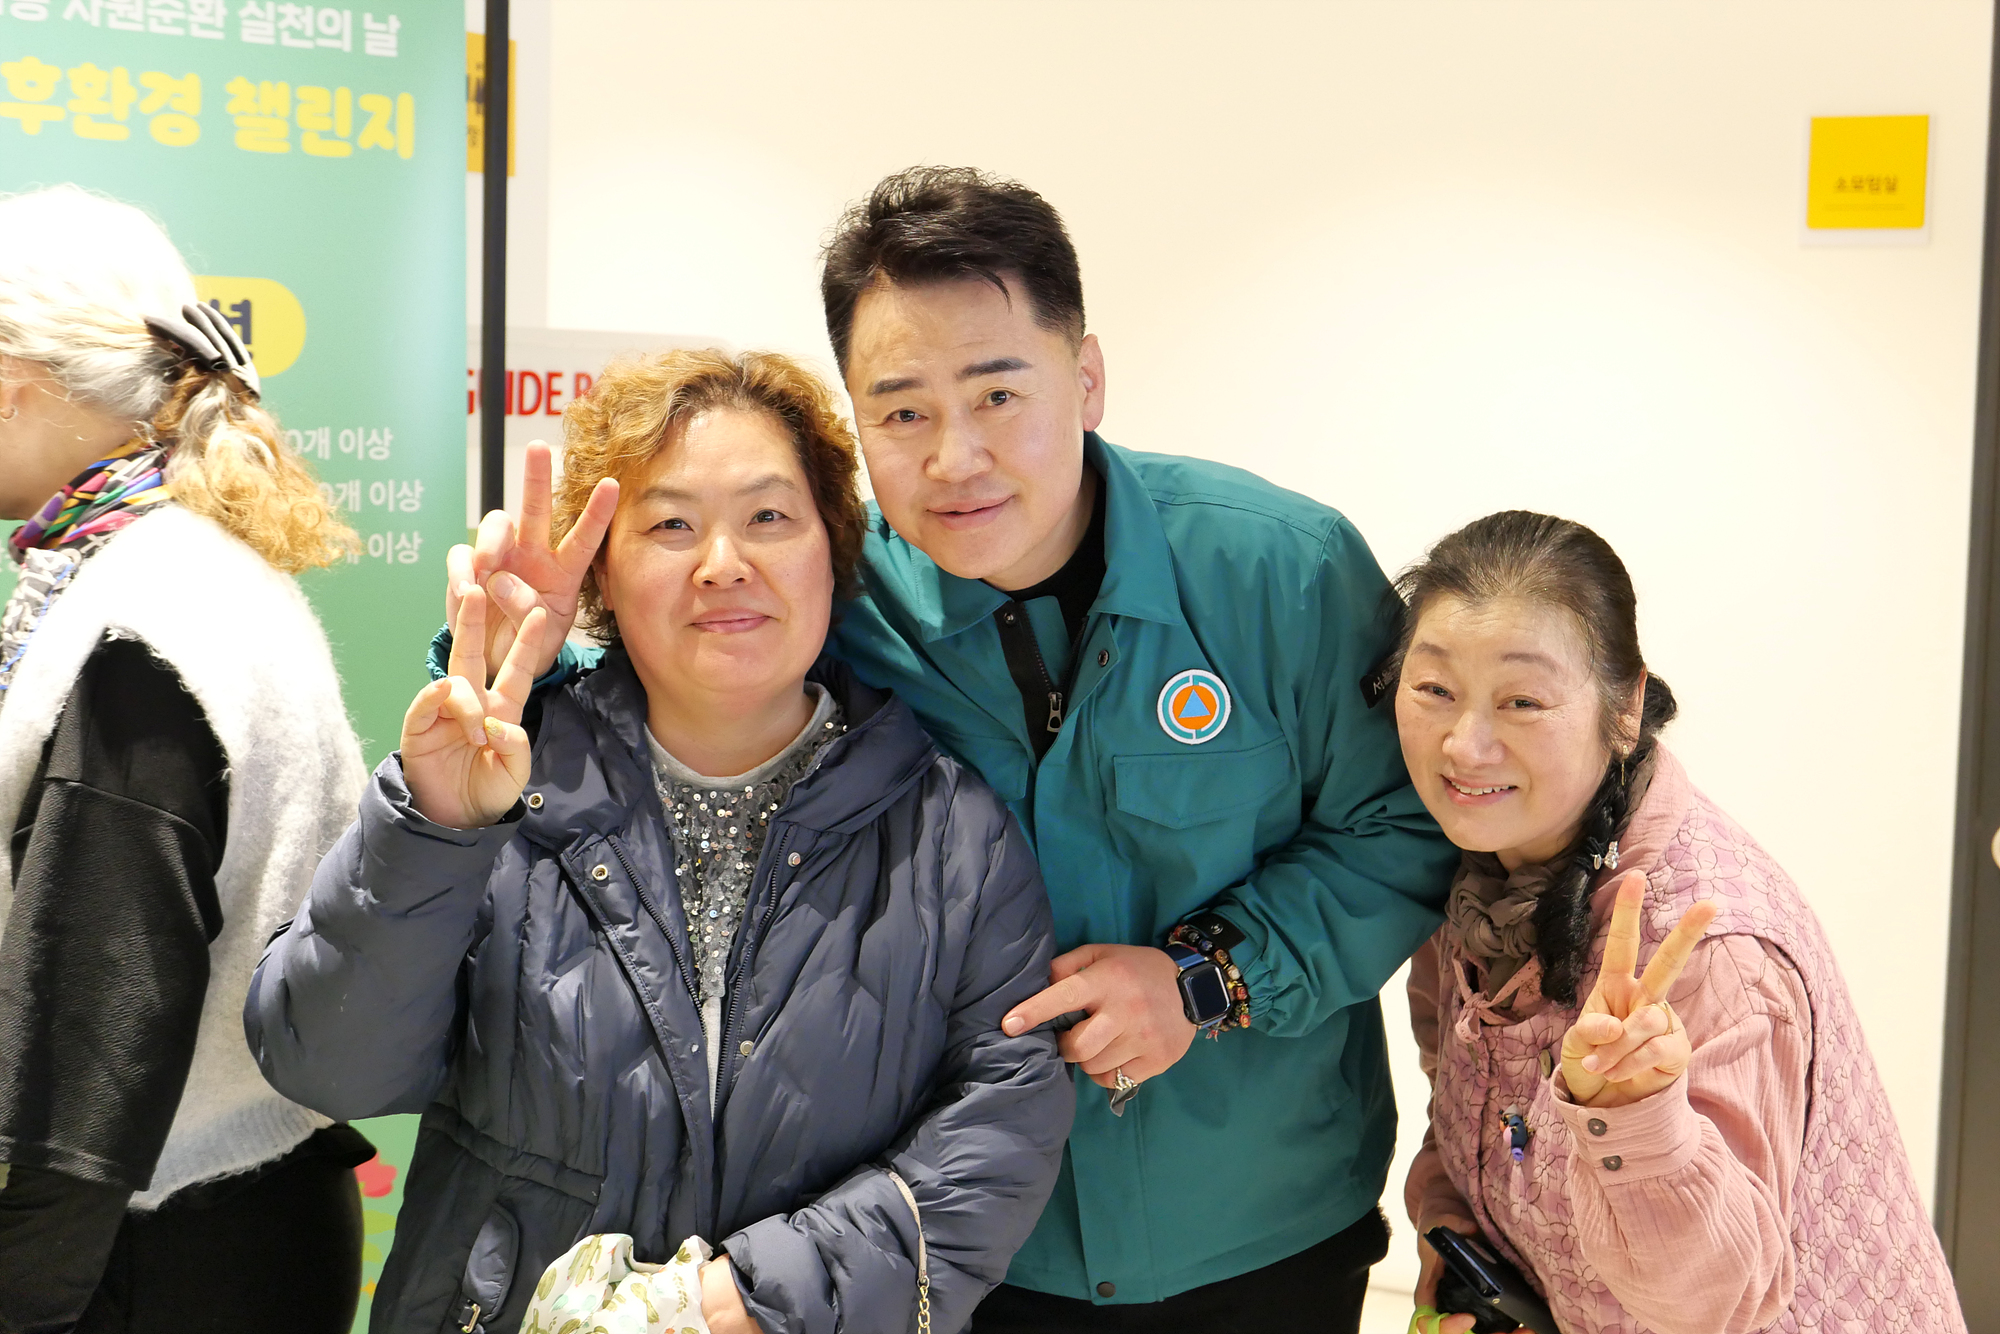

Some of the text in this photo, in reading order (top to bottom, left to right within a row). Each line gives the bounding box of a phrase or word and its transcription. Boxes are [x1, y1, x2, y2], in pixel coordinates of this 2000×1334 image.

[238, 1, 353, 52] 실천의
[363, 12, 402, 57] 날
[0, 56, 203, 147] 후환경
[226, 77, 416, 160] 챌린지
[467, 369, 564, 416] IDE
[338, 427, 394, 460] 이상
[369, 479, 425, 512] 이상
[367, 531, 424, 564] 이상
